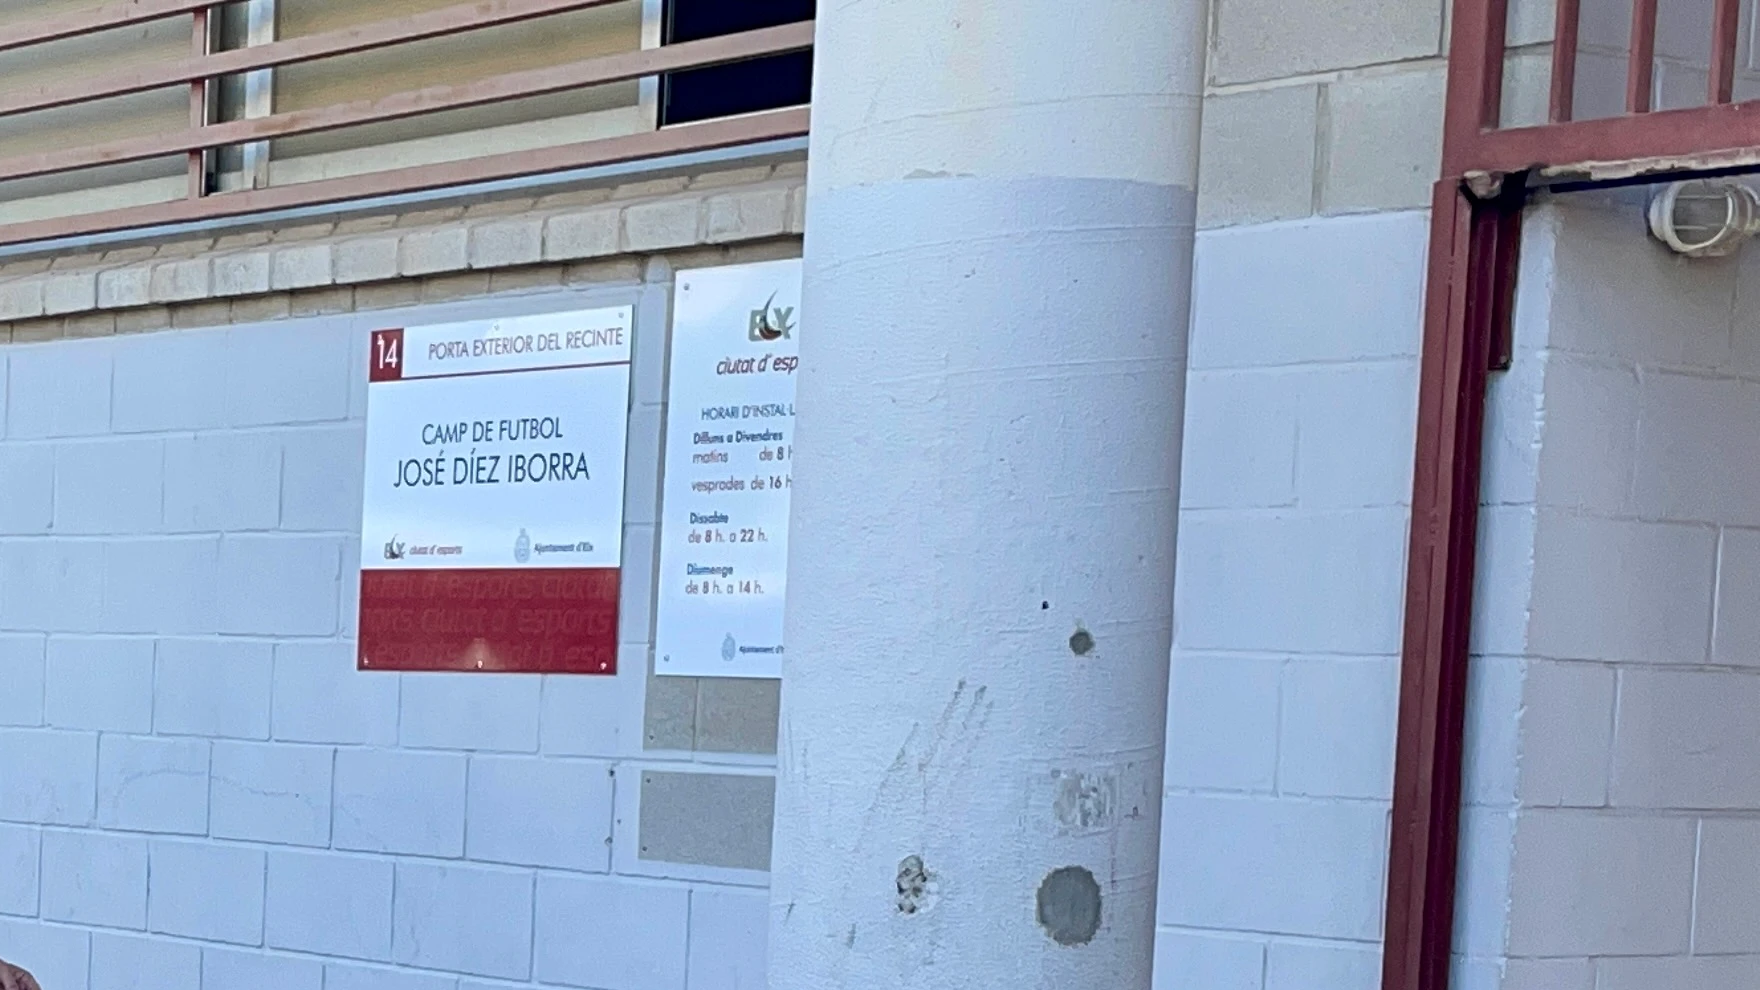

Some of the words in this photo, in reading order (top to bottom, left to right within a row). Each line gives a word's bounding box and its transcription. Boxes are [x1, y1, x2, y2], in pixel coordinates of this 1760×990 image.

[377, 337, 398, 369] 14
[428, 342, 469, 361] PORTA
[473, 335, 534, 357] EXTERIOR
[537, 331, 561, 352] DEL
[566, 326, 624, 350] RECINTE
[716, 356, 755, 375] ciutat
[701, 406, 739, 421] HORARI
[422, 421, 468, 445] CAMP
[472, 420, 494, 443] DE
[498, 416, 564, 442] FUTBOL
[735, 429, 784, 443] Divendres
[692, 449, 729, 464] matins
[758, 445, 774, 461] de
[776, 446, 785, 460] 8
[393, 450, 446, 488] JOSÉ
[452, 447, 501, 485] DÍEZ
[507, 452, 590, 484] IBORRA
[690, 475, 746, 494] vesprades
[751, 474, 765, 490] de
[769, 475, 783, 489] 16
[689, 511, 729, 525] Dissabte
[687, 529, 702, 544] de
[704, 529, 713, 543] 8
[729, 533, 737, 543] a
[740, 528, 755, 543] 22
[757, 527, 769, 542] h.
[686, 563, 734, 579] Diumenge
[685, 580, 699, 595] de
[701, 580, 710, 594] 8
[726, 584, 734, 594] a
[739, 580, 752, 593] 14
